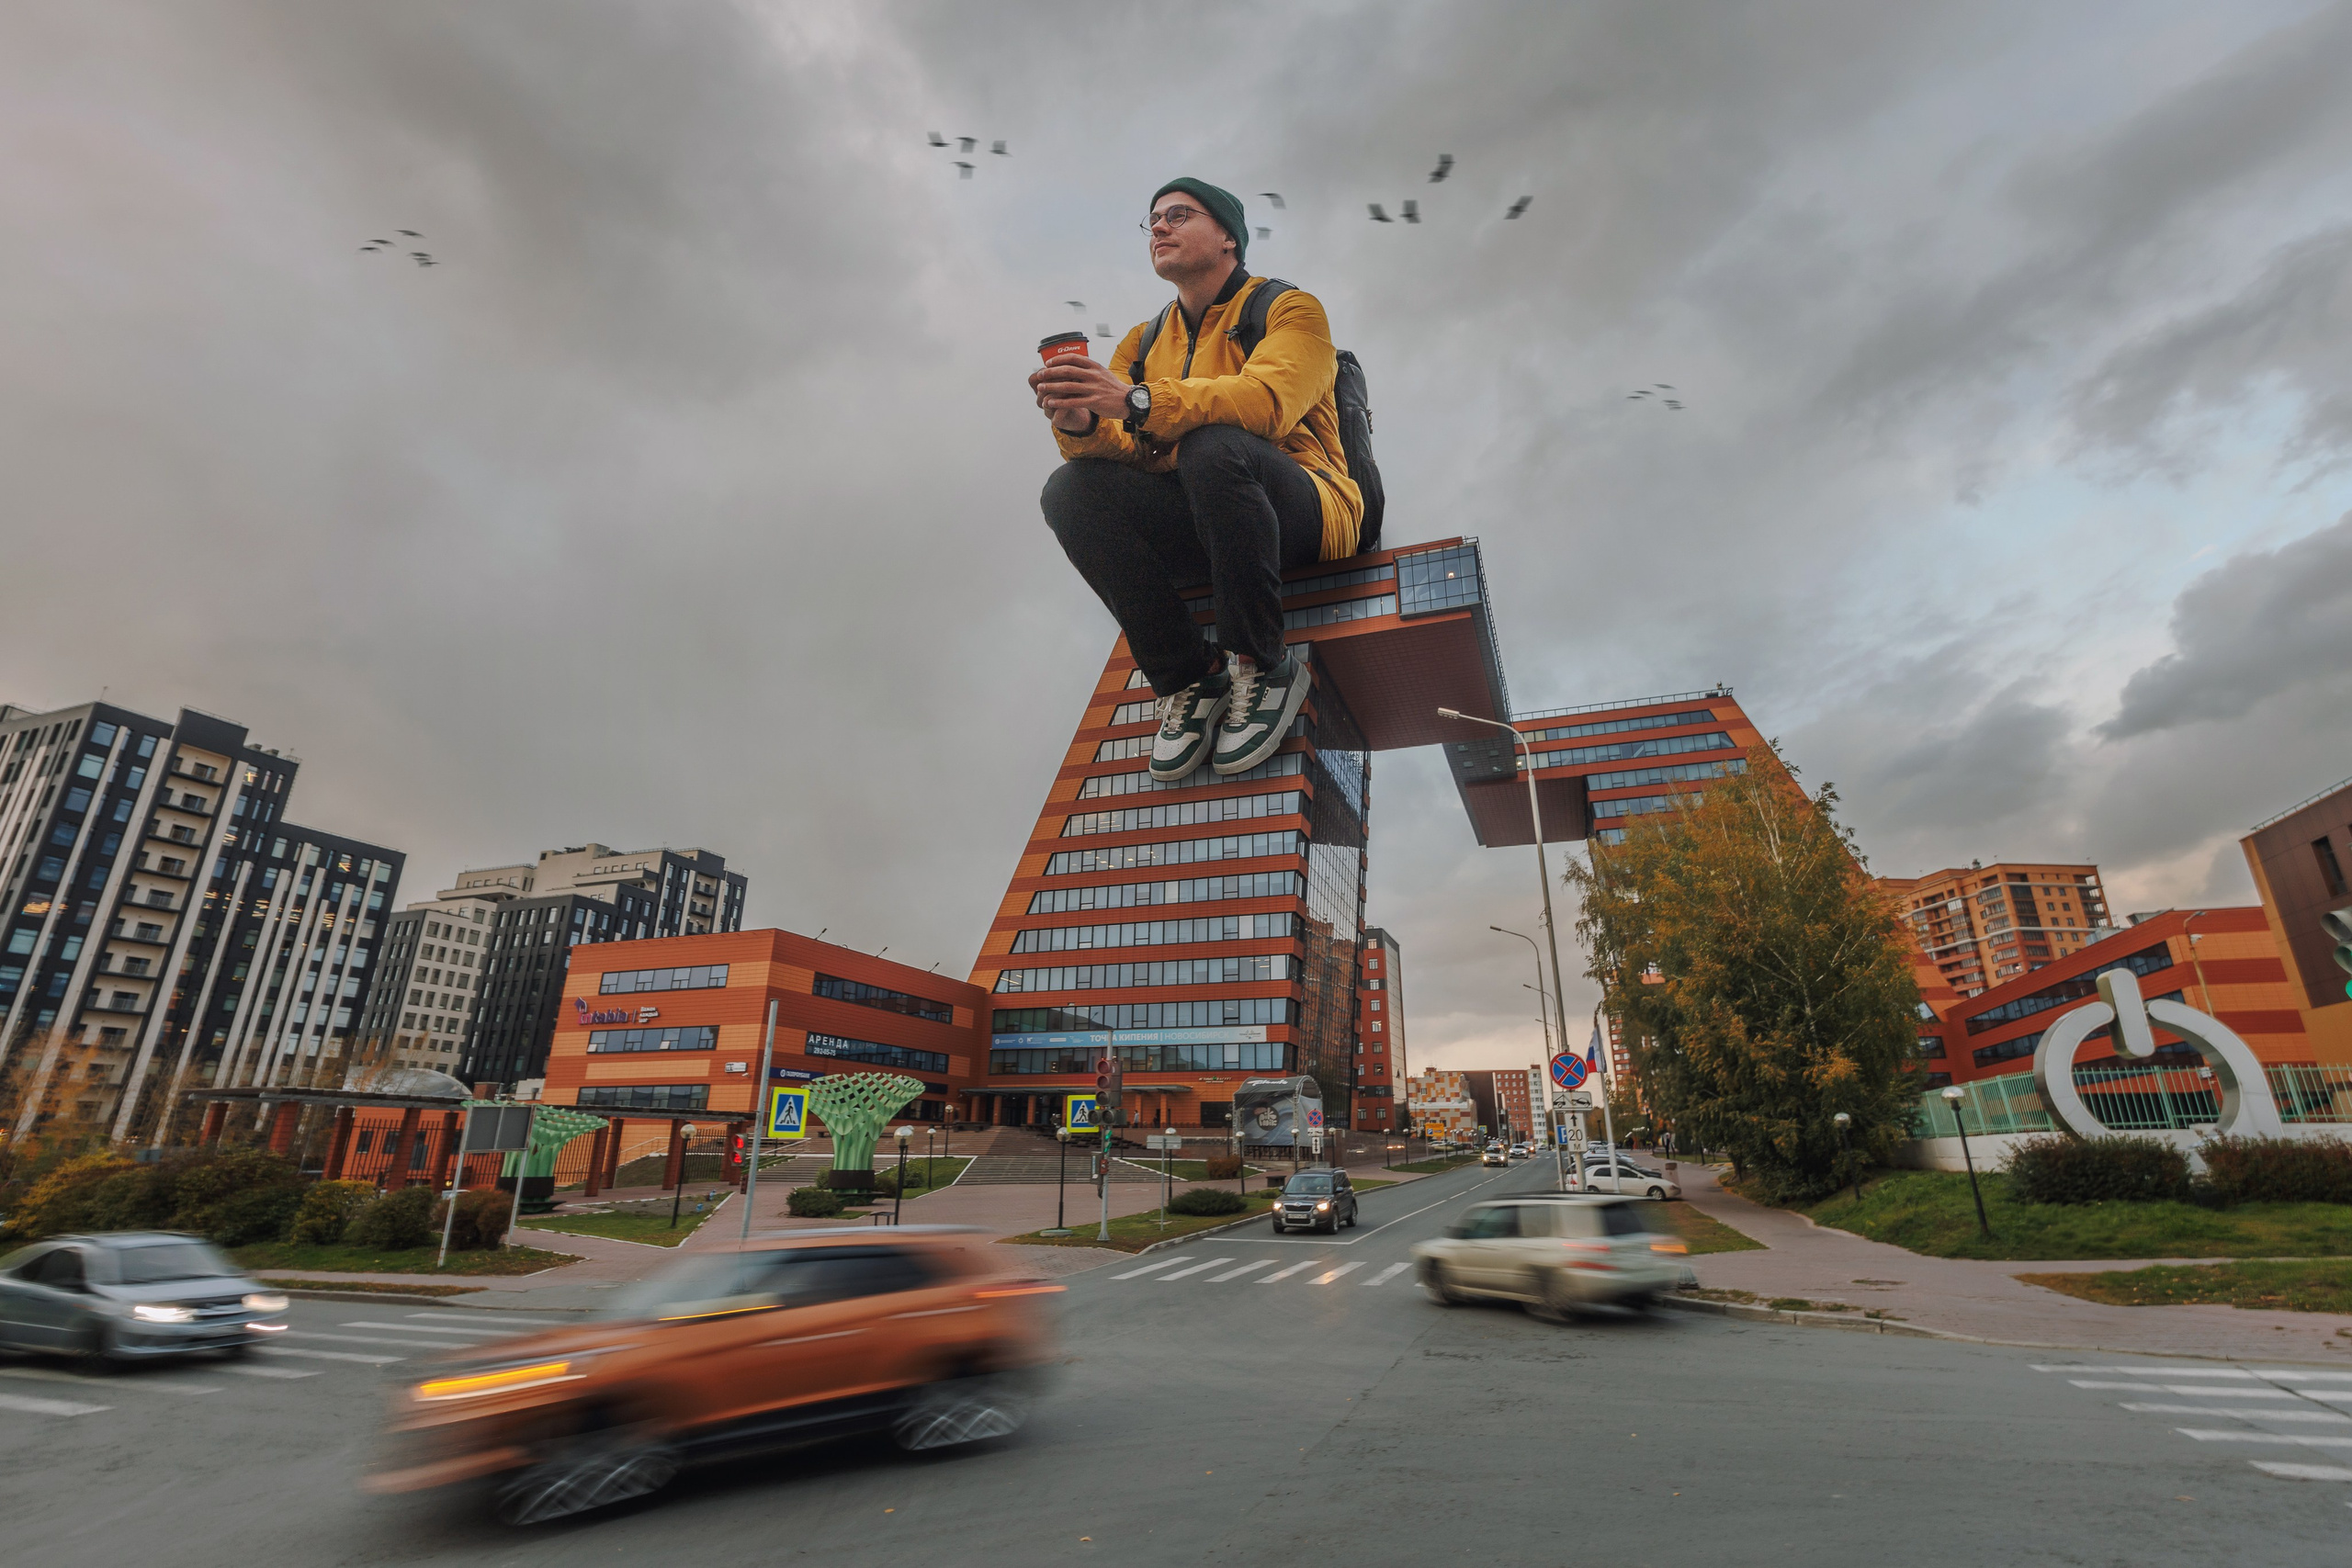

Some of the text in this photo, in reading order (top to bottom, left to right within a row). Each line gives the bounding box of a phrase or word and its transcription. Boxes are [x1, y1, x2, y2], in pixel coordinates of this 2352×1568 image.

[808, 1034, 849, 1050] АРЕНДА
[1090, 1033, 1117, 1043] ТОЧА
[1118, 1032, 1159, 1042] КИПЕНИЯ
[1164, 1031, 1229, 1041] НОВОСИБИРСК
[1568, 1129, 1583, 1141] 20
